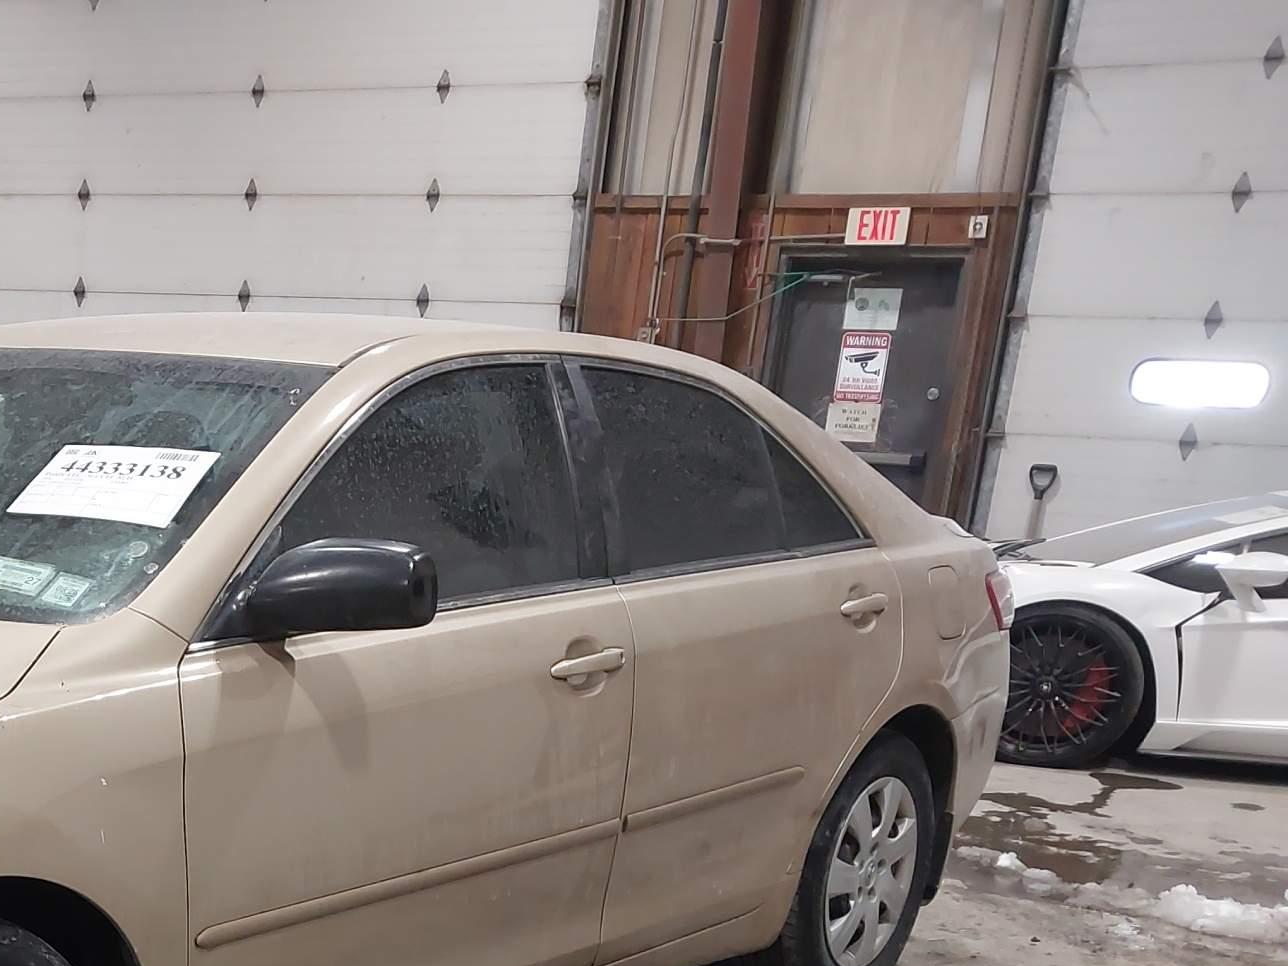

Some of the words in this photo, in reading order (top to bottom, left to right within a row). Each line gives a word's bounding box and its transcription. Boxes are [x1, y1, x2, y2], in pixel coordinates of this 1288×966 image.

[856, 209, 901, 241] EXIT
[845, 335, 888, 347] WARNING
[60, 459, 187, 480] 44333138
